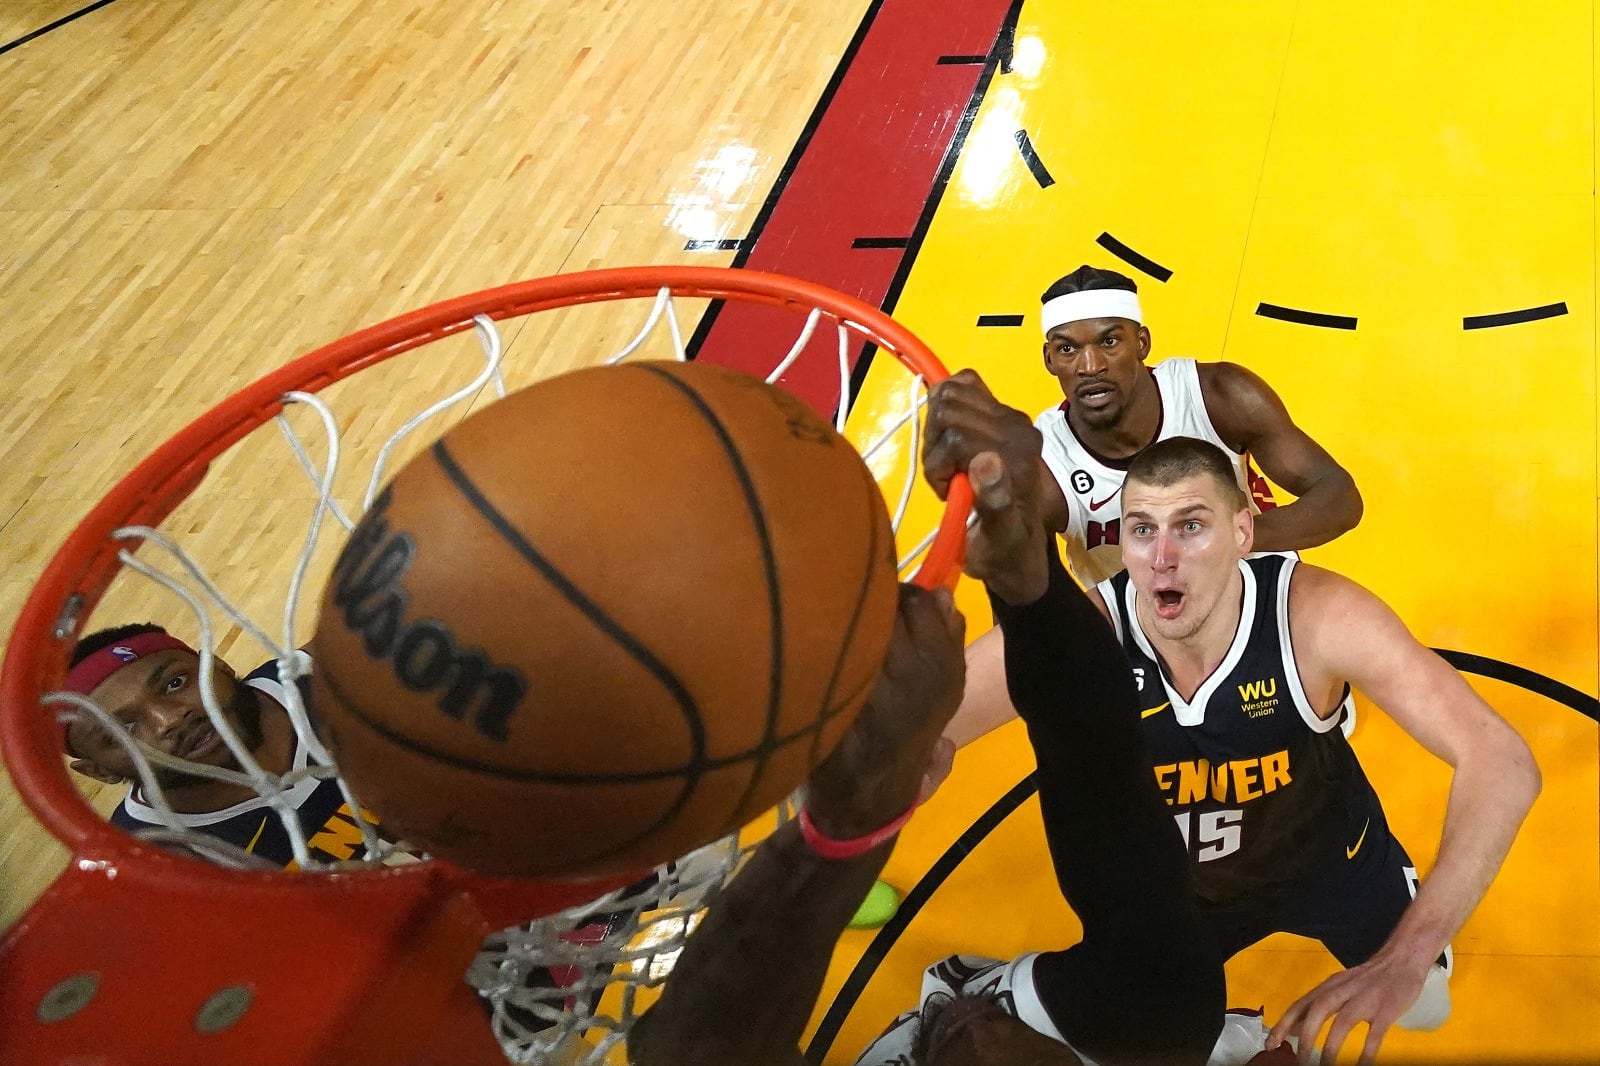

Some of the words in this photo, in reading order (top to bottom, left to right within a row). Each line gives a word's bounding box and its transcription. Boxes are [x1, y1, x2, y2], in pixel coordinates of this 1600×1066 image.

[1073, 472, 1091, 493] 6
[327, 484, 528, 742] ilson
[1238, 677, 1277, 702] WU
[1241, 698, 1279, 713] Western
[1249, 707, 1275, 719] Union
[1153, 749, 1293, 806] ENVER
